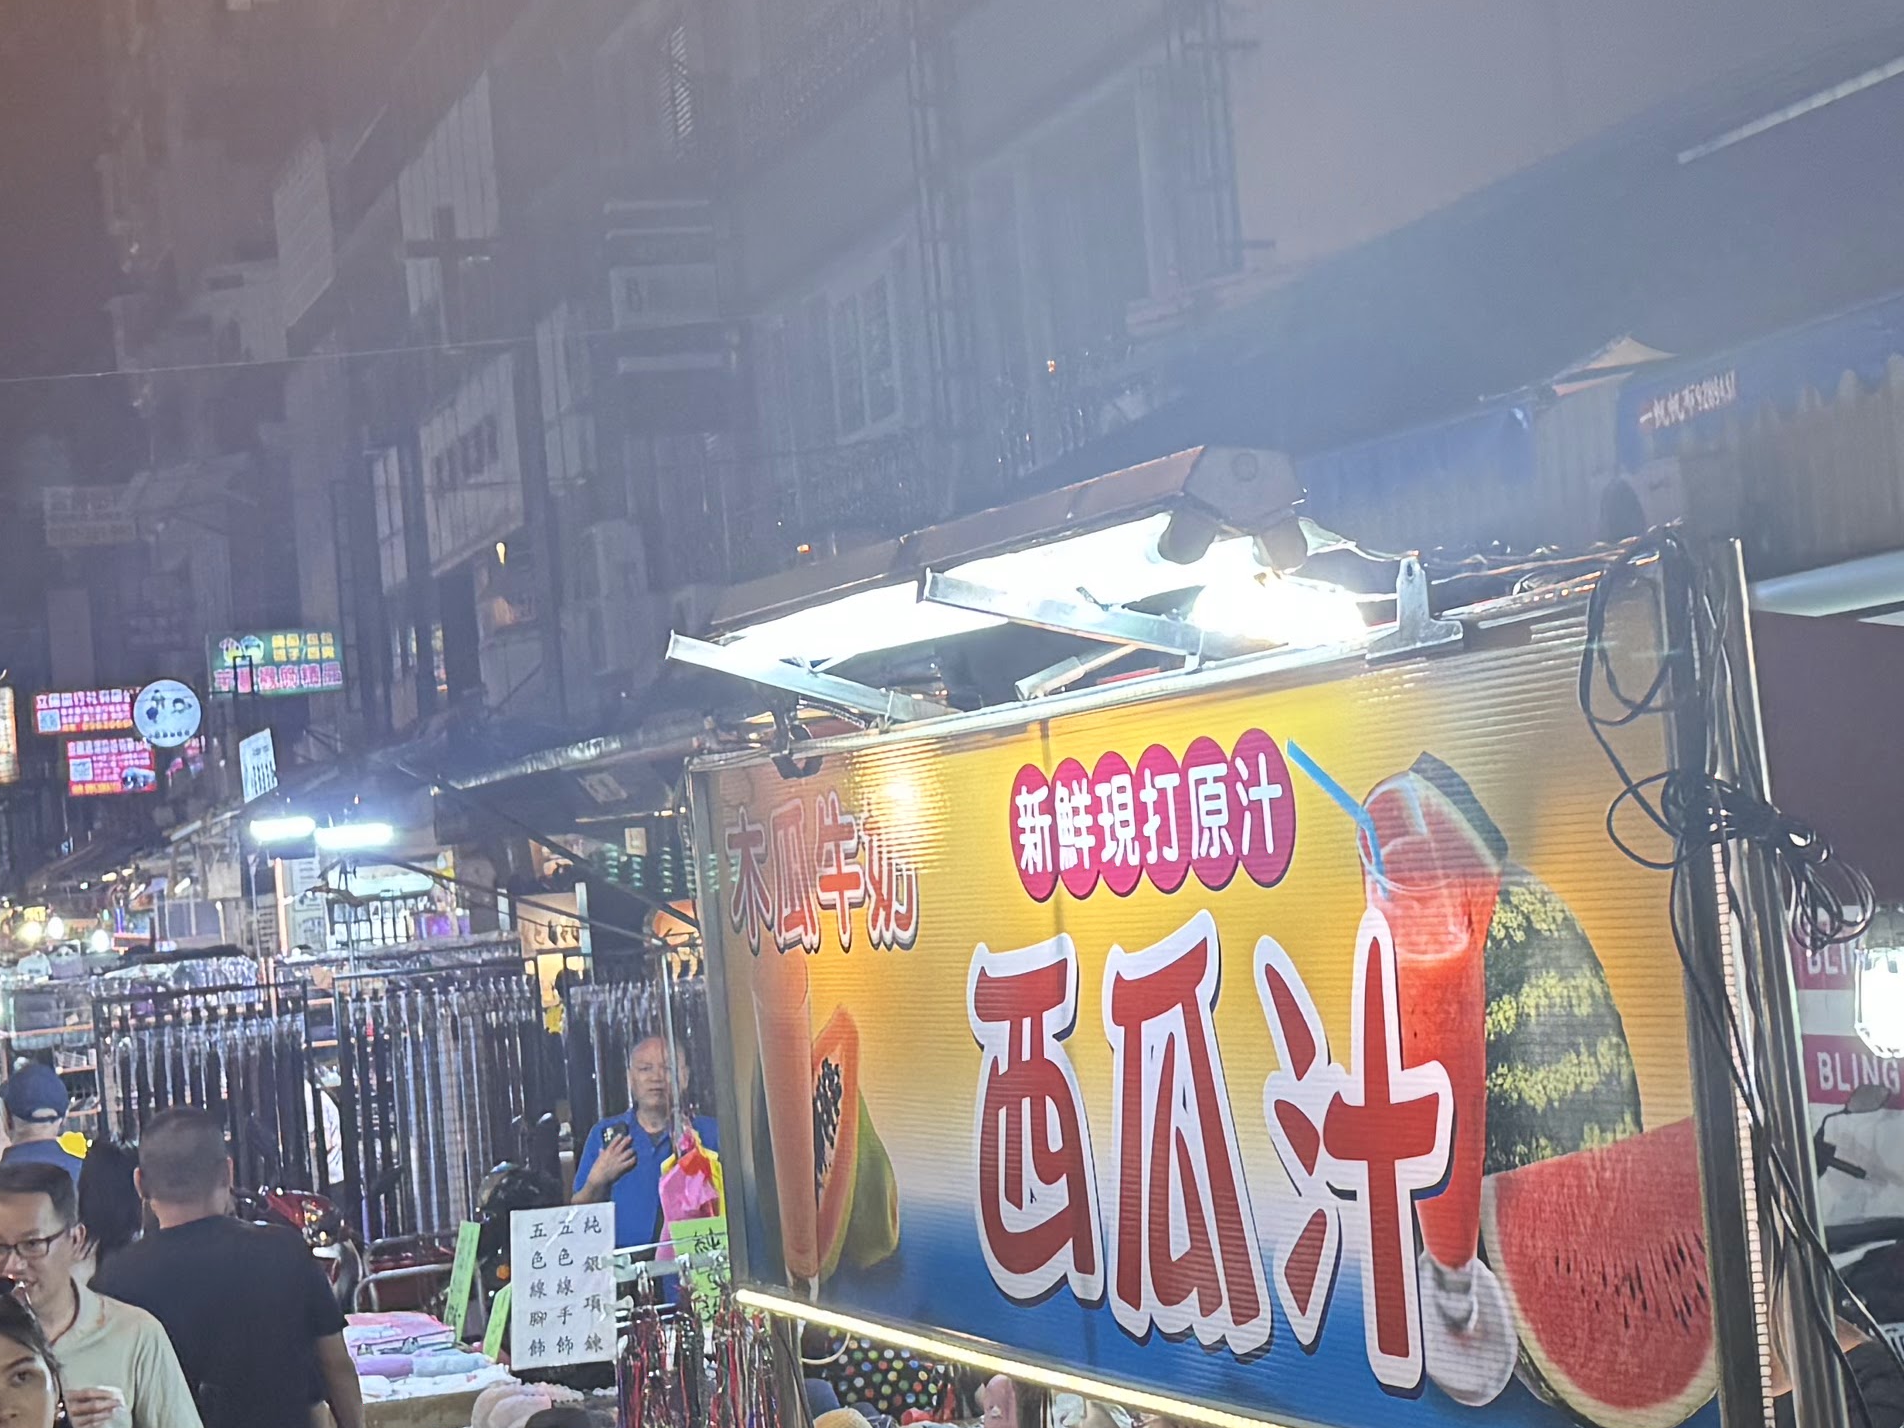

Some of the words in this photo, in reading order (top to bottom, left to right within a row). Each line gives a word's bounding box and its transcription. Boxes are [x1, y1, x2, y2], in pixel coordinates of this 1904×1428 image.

[726, 791, 920, 954] 木瓜牛奶
[1014, 752, 1284, 876] 新鮮現打原汁
[1817, 1051, 1901, 1095] BLING
[969, 909, 1453, 1388] 西瓜汁
[528, 1223, 547, 1357] 五色線腳飾
[556, 1220, 574, 1357] 五色線手飾
